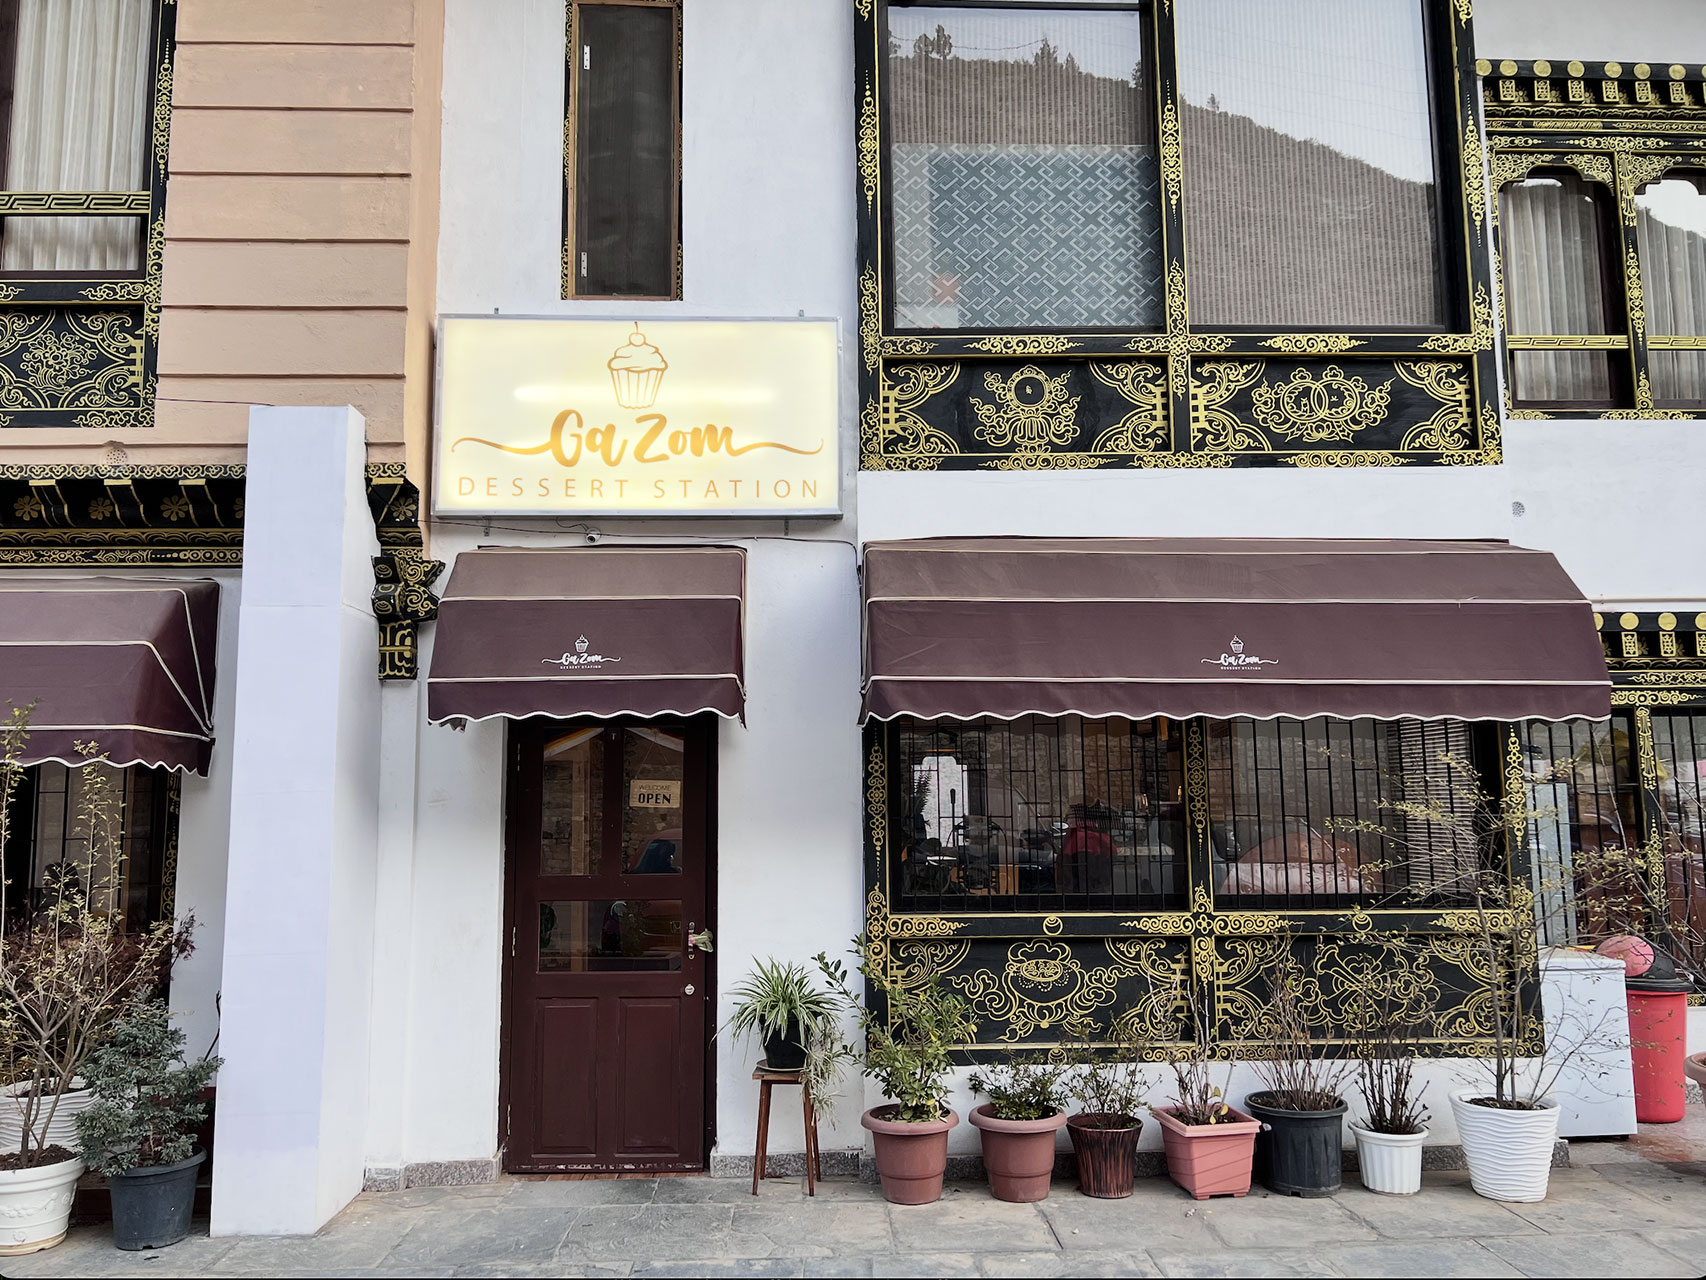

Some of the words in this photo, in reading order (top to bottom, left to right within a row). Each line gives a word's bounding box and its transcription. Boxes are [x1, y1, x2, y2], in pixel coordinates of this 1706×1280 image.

[550, 409, 628, 468] Ga
[633, 413, 744, 464] Zom
[458, 476, 628, 498] DESSERT
[654, 479, 818, 499] STATION
[562, 652, 579, 665] Ga
[1220, 653, 1238, 666] Ga
[638, 792, 672, 804] OPEN
